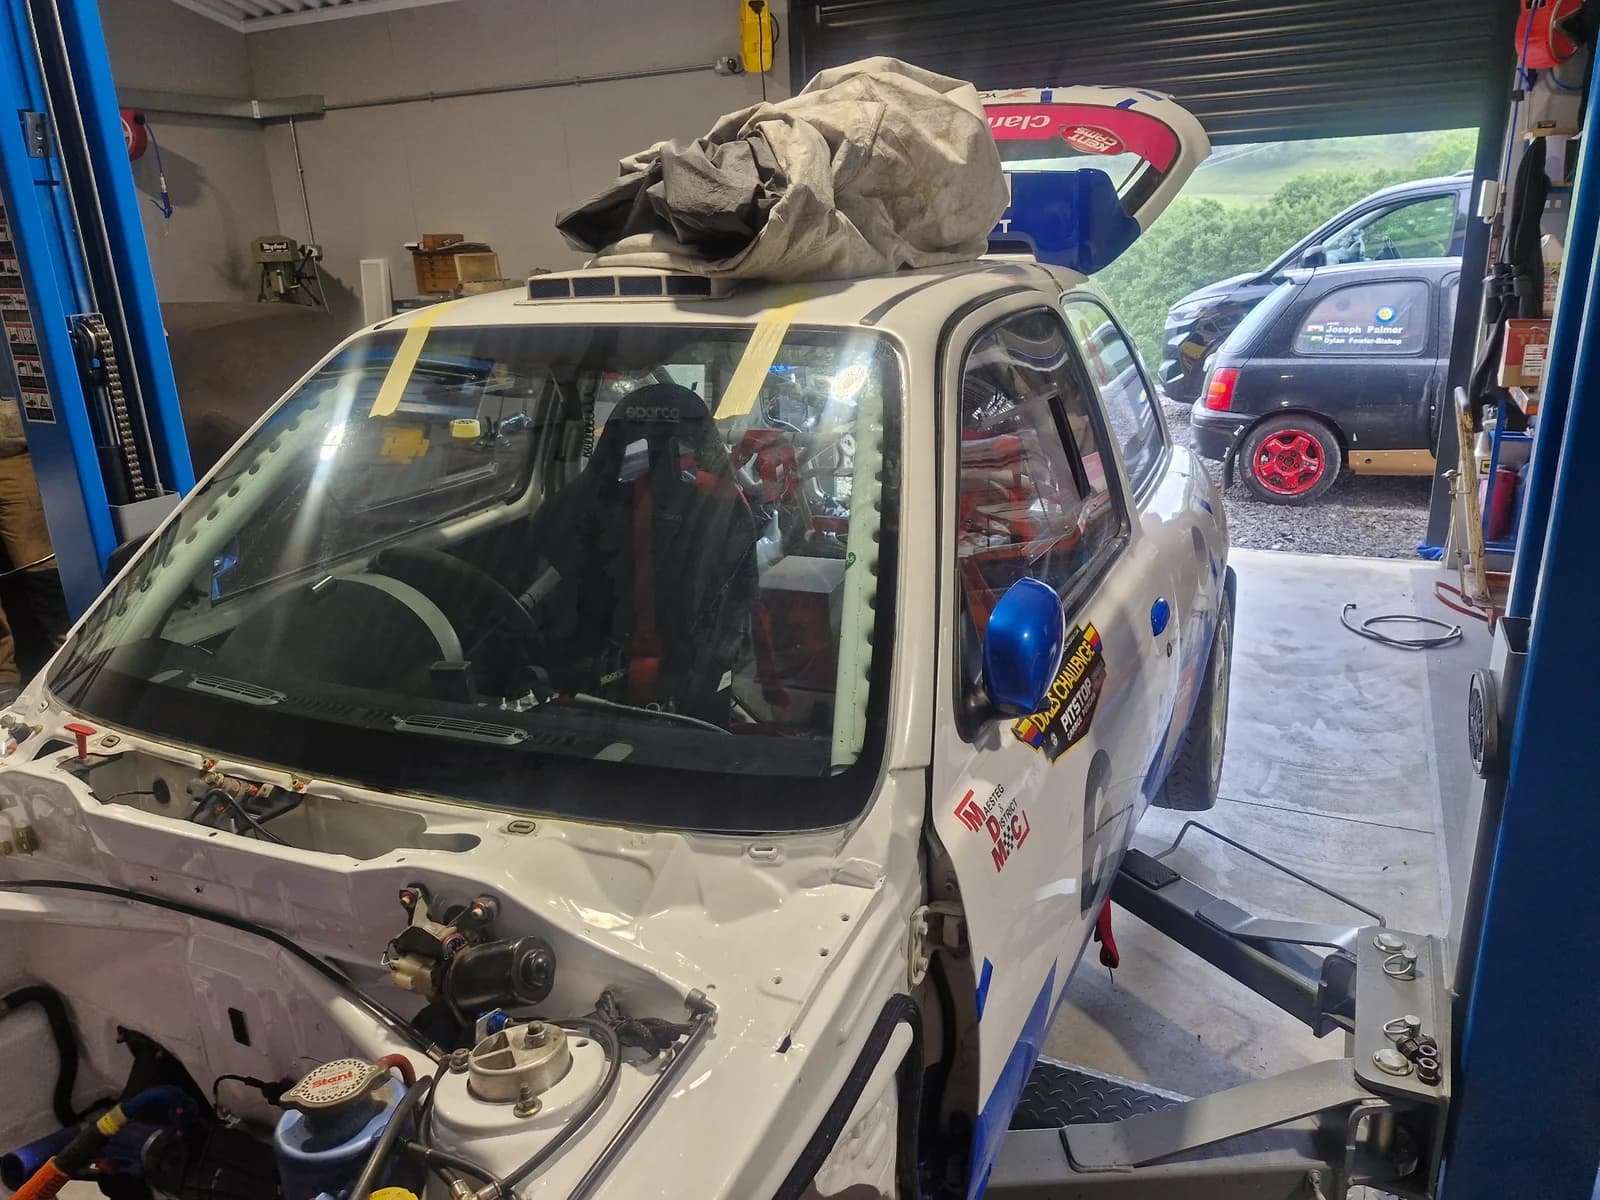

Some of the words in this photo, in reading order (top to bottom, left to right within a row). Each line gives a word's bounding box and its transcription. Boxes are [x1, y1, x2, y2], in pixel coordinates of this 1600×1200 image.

[1325, 325, 1362, 335] Joseph
[1367, 325, 1403, 334] Palmer
[1324, 337, 1345, 345] Dylan
[1053, 640, 1096, 700] CHALLENGE
[1060, 677, 1092, 733] PITSTOP
[311, 1070, 353, 1089] Stant
